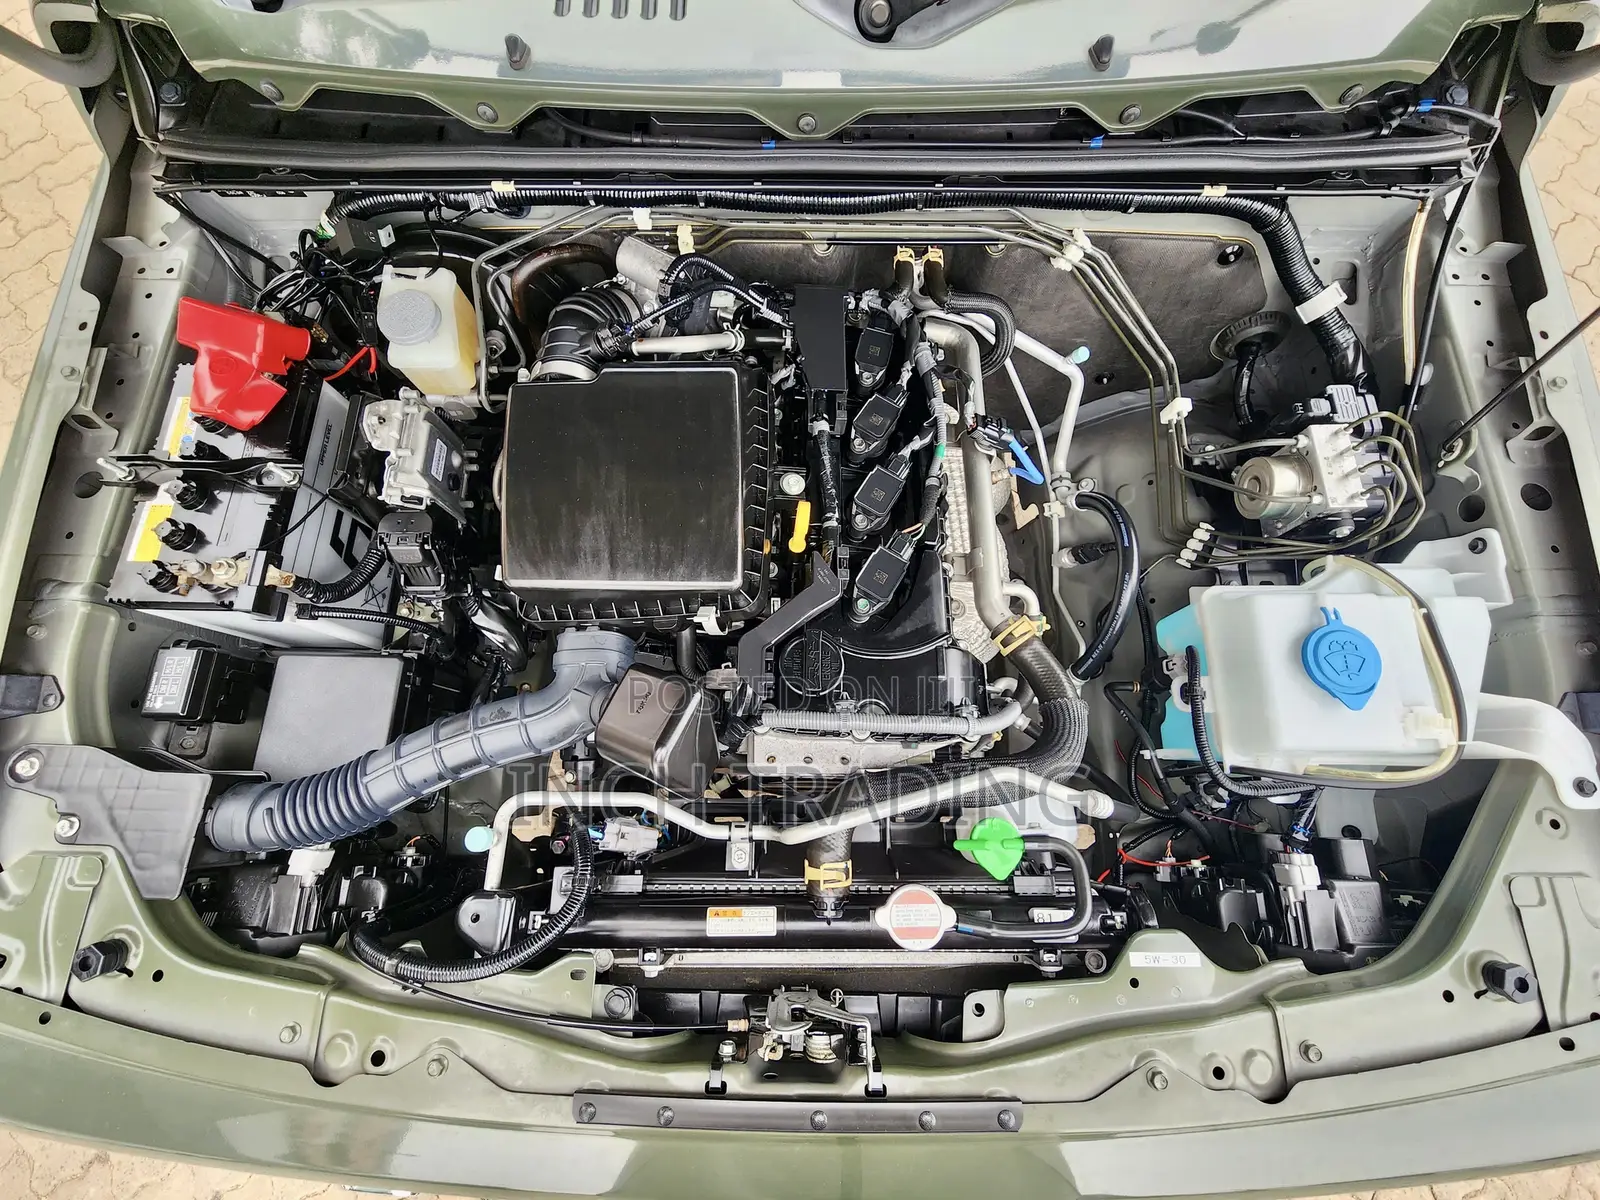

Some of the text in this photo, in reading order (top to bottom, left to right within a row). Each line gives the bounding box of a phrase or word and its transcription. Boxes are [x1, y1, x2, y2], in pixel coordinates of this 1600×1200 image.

[325, 423, 333, 444] LEVEL
[822, 650, 831, 681] ENGINE
[1144, 954, 1187, 965] 5W-30
